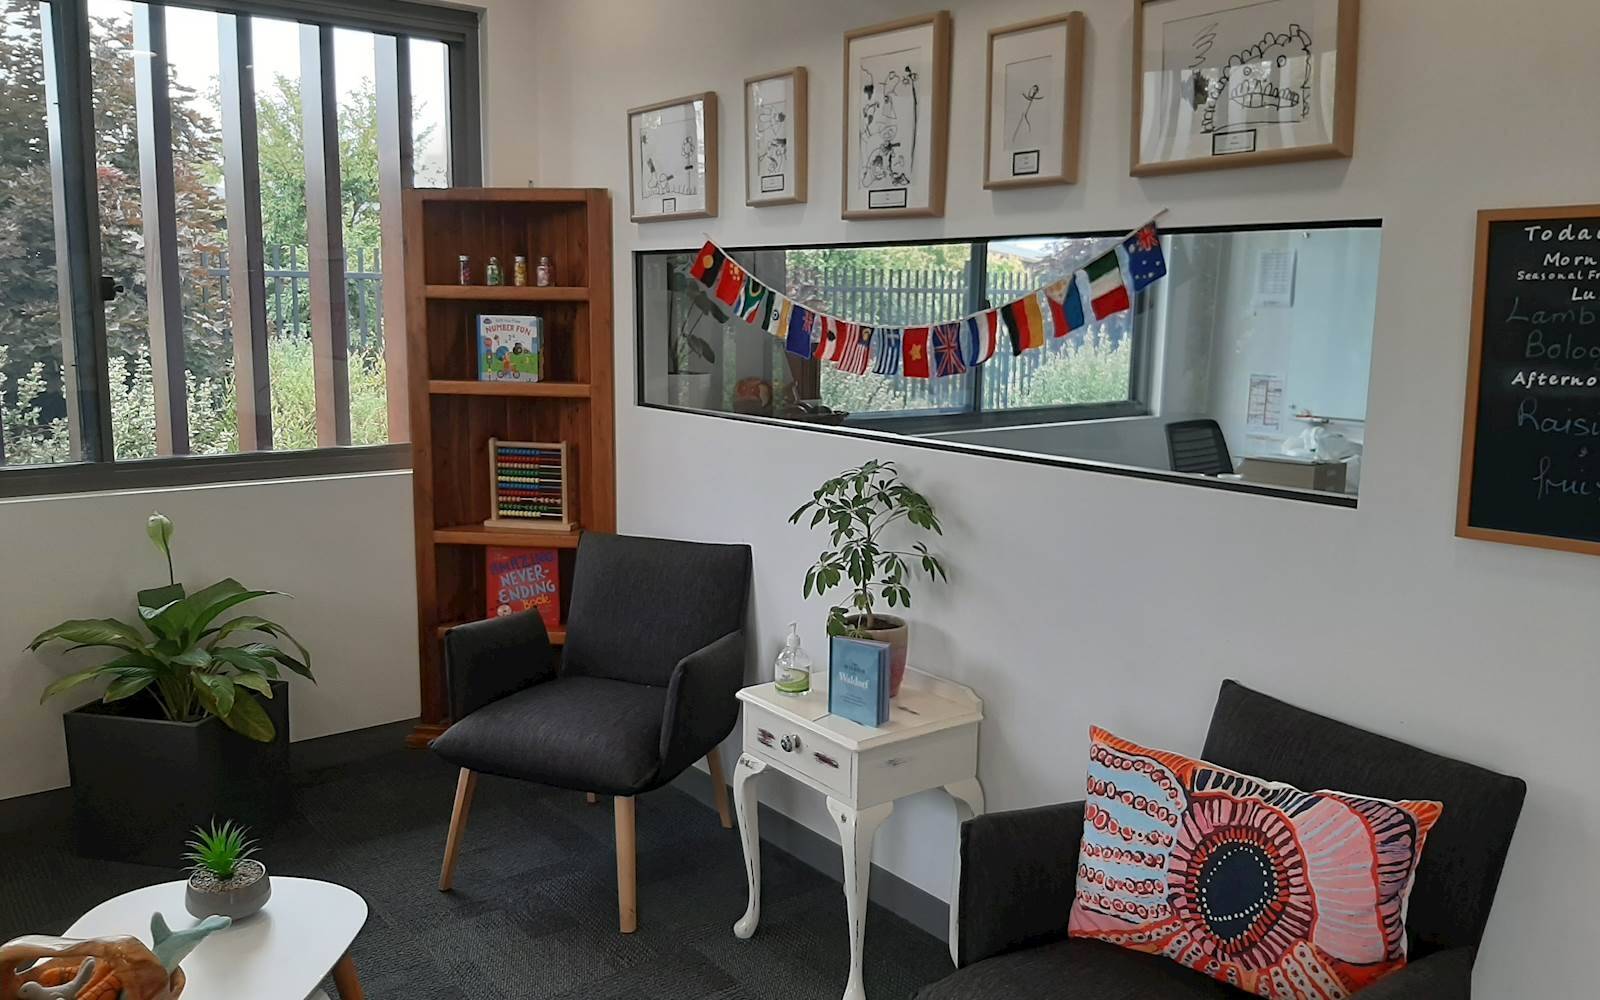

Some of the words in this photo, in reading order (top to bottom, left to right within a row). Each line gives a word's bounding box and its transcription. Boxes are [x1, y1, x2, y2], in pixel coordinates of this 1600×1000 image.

[1517, 270, 1583, 281] Seasonal
[1571, 287, 1596, 301] Lu
[1505, 296, 1596, 325] Lamb
[486, 323, 514, 334] NUMBER
[515, 325, 531, 336] FUN
[1511, 371, 1597, 389] Afterno
[1532, 455, 1600, 501] frui
[500, 564, 549, 588] NEVER-
[498, 579, 556, 604] ENDING
